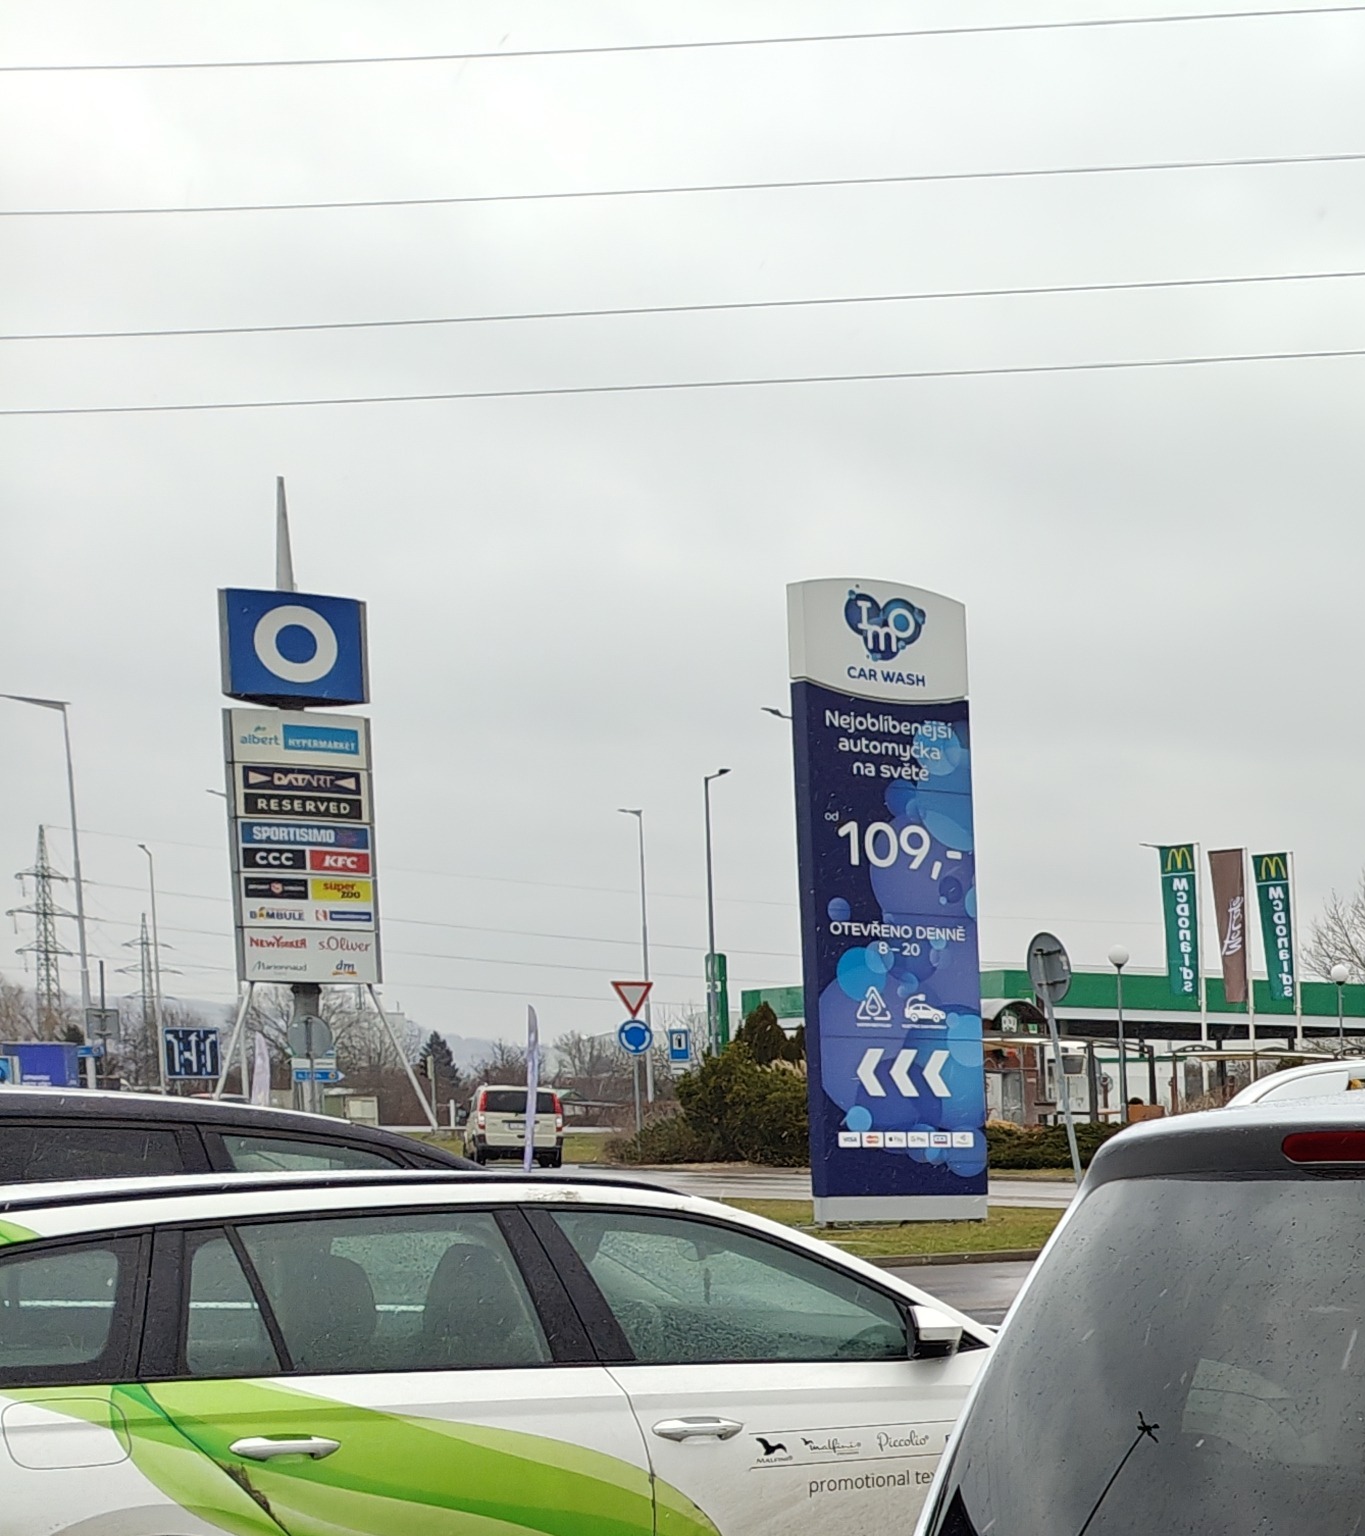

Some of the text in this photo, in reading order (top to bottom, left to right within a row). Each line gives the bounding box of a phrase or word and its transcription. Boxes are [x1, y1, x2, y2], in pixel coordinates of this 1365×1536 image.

[847, 666, 926, 687] CAR WASH
[825, 709, 953, 740] Nejoblíbenější
[240, 734, 356, 750] albert HYPERMARKET
[837, 735, 942, 763] automyčka
[852, 760, 929, 782] na světě
[257, 799, 350, 814] RESERVED
[824, 810, 839, 822] od
[252, 826, 335, 844] SPORTISIMO
[255, 851, 294, 865] CCC
[323, 855, 358, 869] KFC
[323, 882, 356, 893] super
[249, 907, 305, 921] BAMBULE
[829, 921, 966, 941] OTEVŘENO DENNĚ
[335, 960, 355, 971] dm
[808, 1469, 910, 1498] promotional
